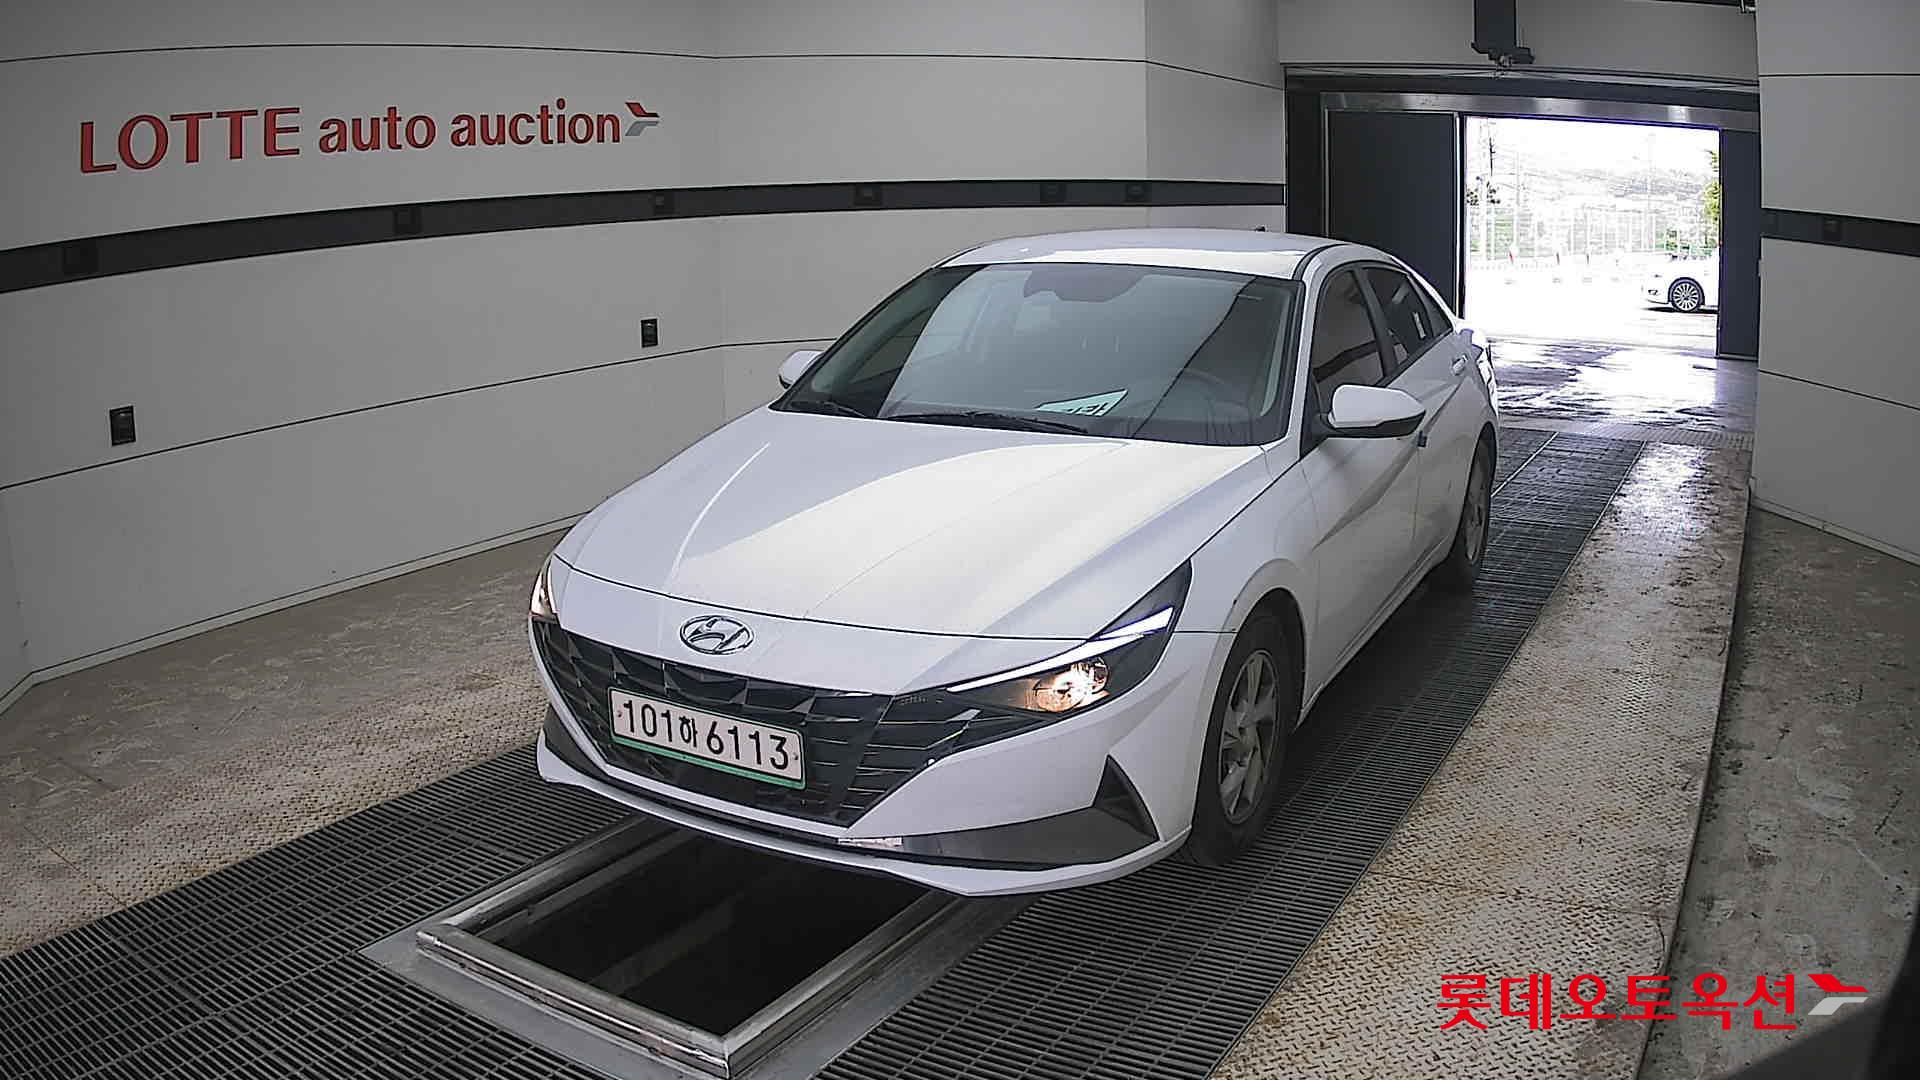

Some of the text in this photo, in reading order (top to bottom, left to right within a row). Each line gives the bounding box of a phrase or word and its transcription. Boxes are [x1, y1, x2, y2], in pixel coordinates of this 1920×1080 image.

[81, 98, 622, 174] LOTTE auto auction
